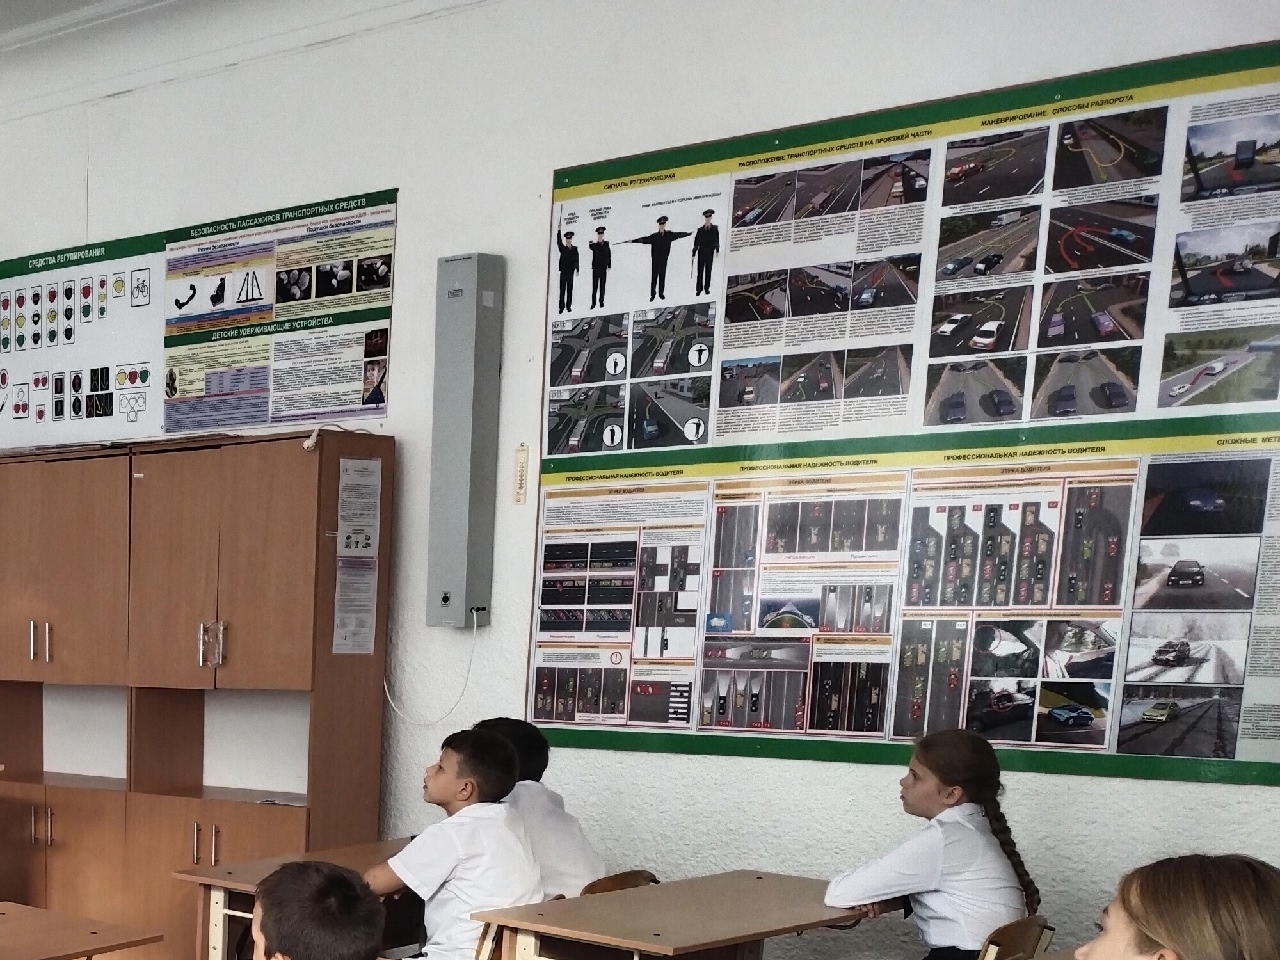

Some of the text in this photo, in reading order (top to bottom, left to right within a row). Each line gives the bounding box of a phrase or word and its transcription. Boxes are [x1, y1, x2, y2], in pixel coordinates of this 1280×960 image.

[835, 141, 863, 153] СРЕДСТВ
[864, 139, 874, 147] НА
[190, 198, 366, 237] БЕЗОПАСНОСТЬ ПАССАЖИРОВ ТРАНСПОРТНЫХ СРЕДСТВ
[28, 247, 106, 269] СРЕДСТВА РЕГУЛИРОВАНИЯ
[212, 316, 334, 341] ДЕТСКИЕ УДЕРЖИВАЮЩИЕ УСТРОЙСТВА
